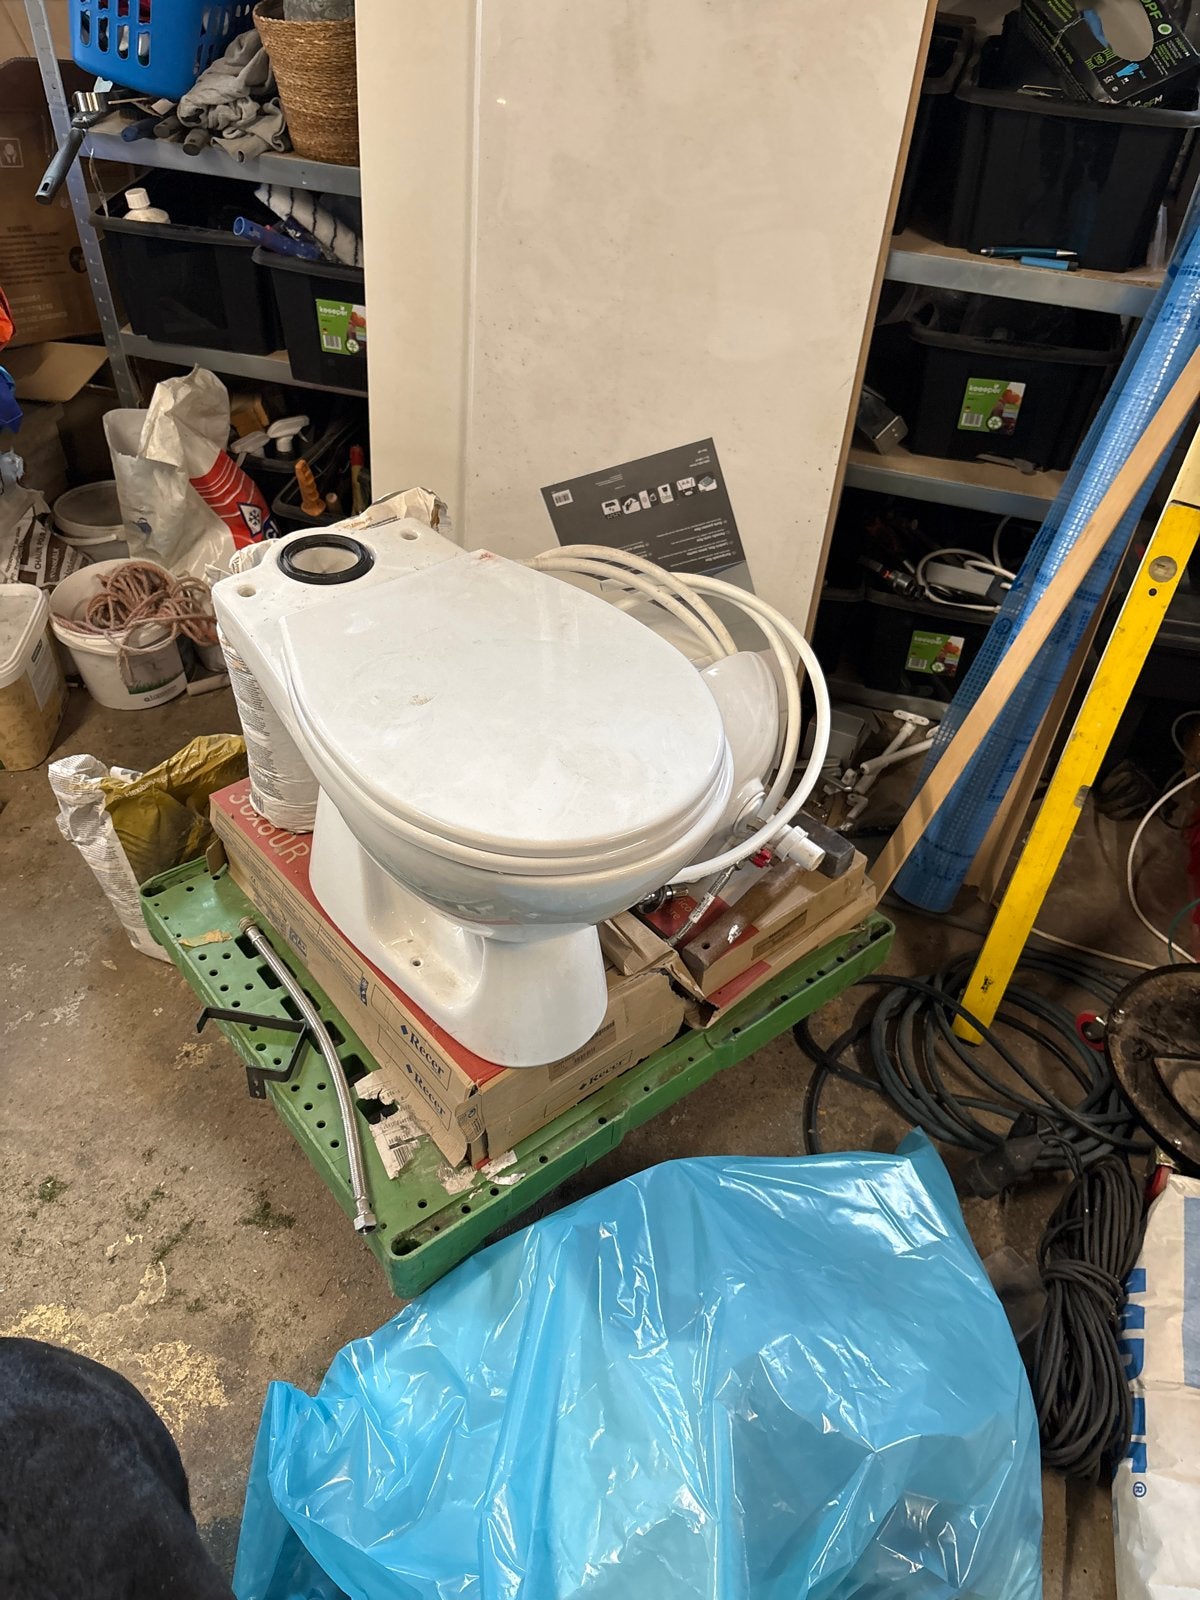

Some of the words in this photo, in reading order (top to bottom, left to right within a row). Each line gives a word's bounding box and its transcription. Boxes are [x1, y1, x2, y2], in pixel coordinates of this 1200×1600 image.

[410, 1033, 444, 1076] Recer
[589, 1059, 625, 1085] Recer
[414, 1073, 446, 1115] Recer
